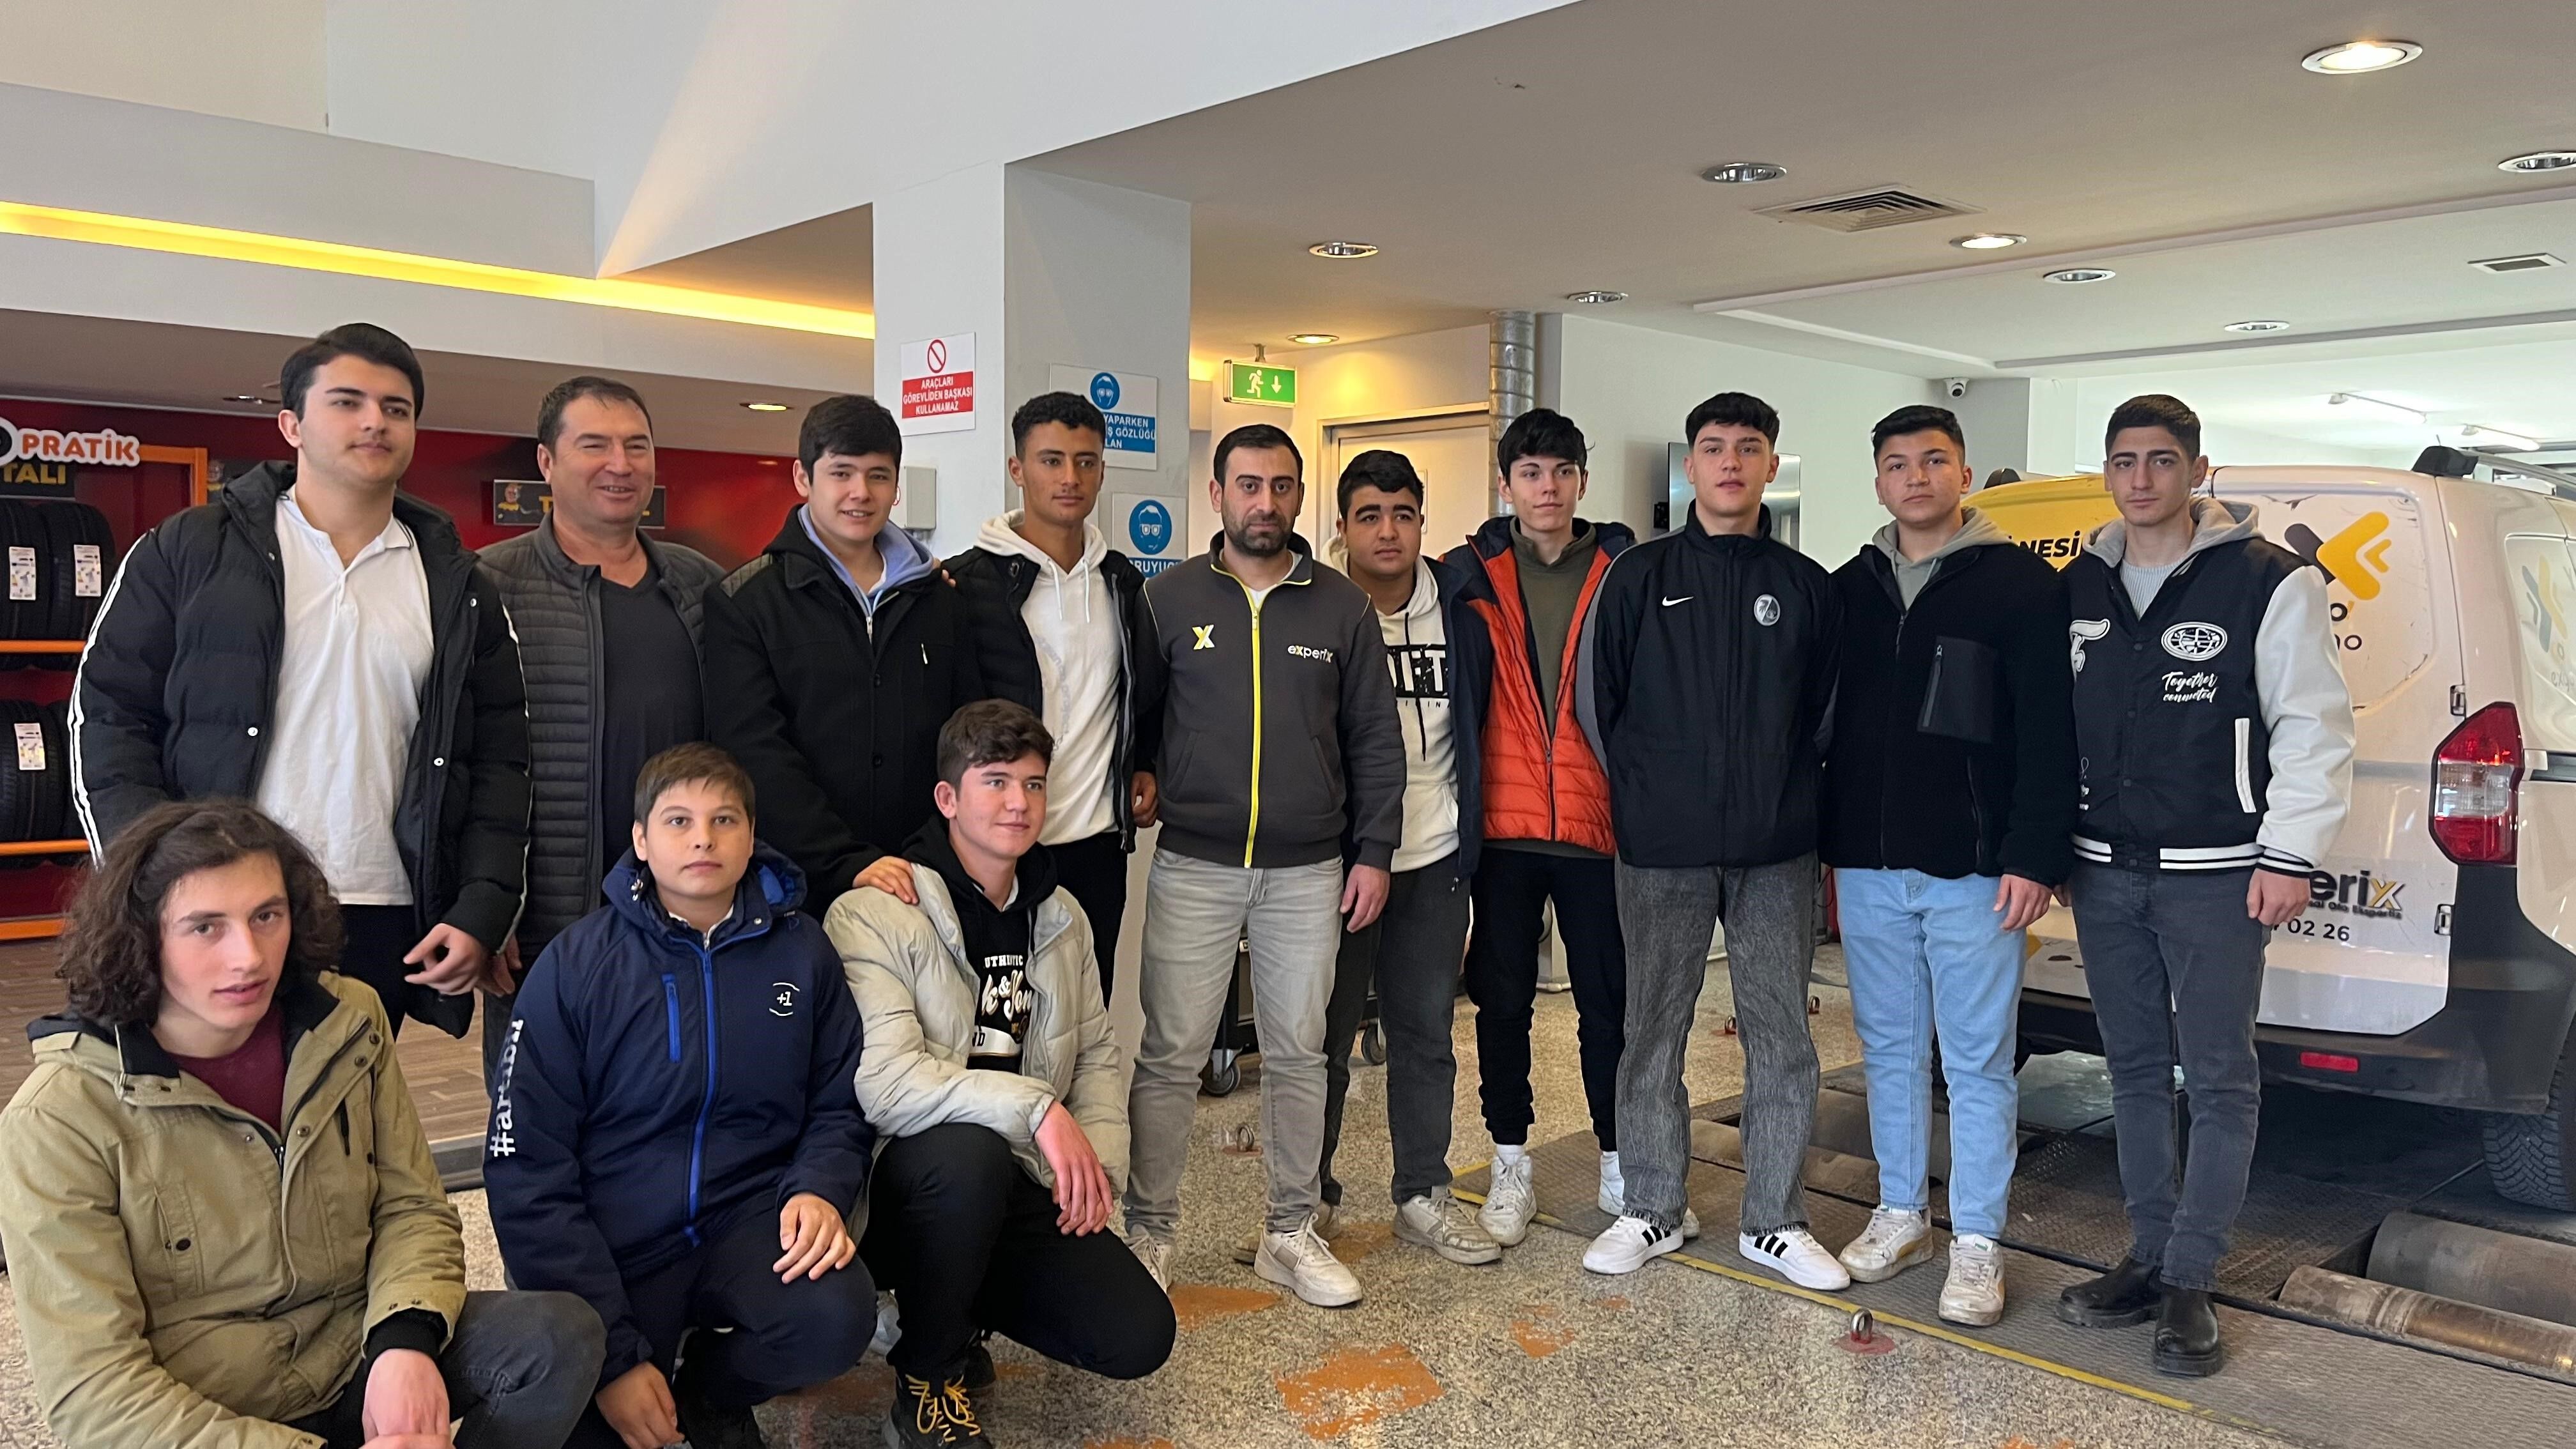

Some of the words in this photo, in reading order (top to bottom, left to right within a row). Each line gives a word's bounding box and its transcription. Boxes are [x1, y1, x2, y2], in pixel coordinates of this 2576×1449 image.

[921, 376, 954, 390] ARAÇLARI
[903, 389, 943, 404] GÖREVLİDEN
[944, 387, 972, 401] BAŞKASI
[916, 401, 959, 415] KULLANAMAZ
[1103, 413, 1149, 428] YAPARKEN
[22, 433, 135, 461] PRATİK
[1105, 438, 1123, 448] LAN
[3, 462, 66, 484] TALI
[2018, 530, 2081, 558] NESİ
[2161, 671, 2218, 692] Together
[2163, 687, 2218, 703] connected
[2309, 869, 2406, 910] erix
[2322, 923, 2350, 942] 26
